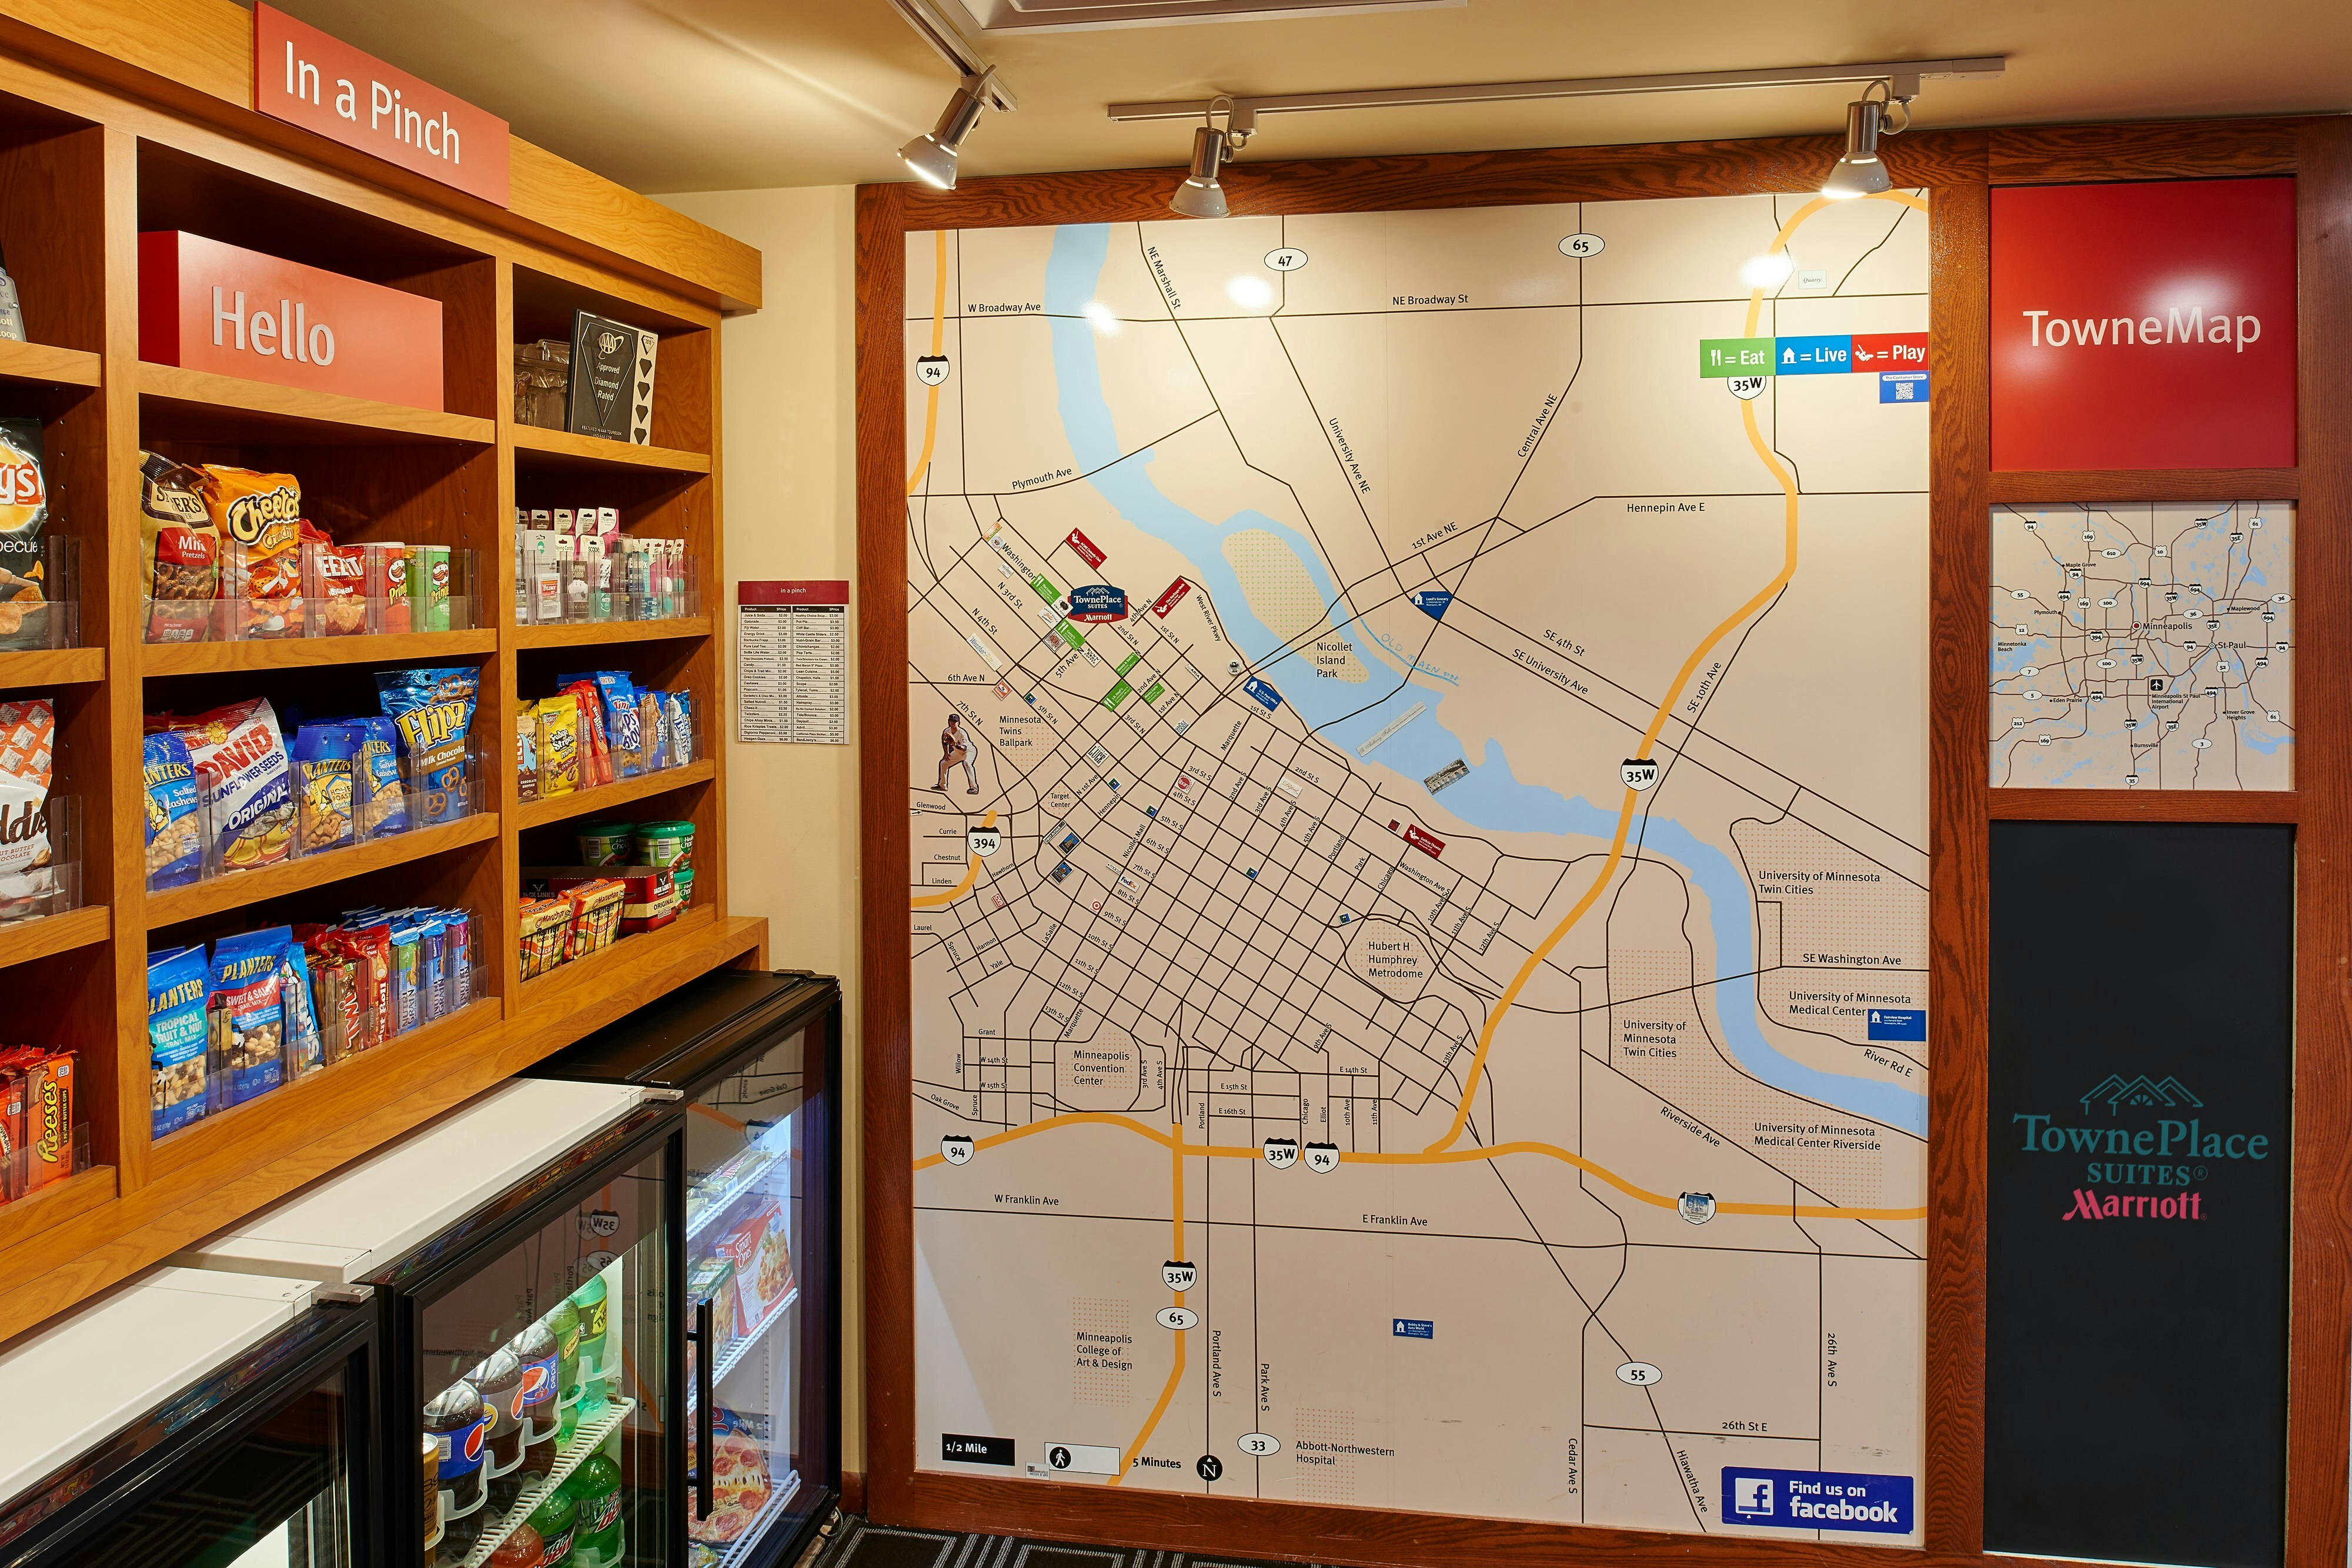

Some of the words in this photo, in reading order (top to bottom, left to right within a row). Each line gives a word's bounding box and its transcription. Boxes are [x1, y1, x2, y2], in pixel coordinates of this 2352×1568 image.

[286, 40, 320, 105] In
[335, 79, 356, 121] a
[372, 80, 460, 164] Pinch
[1573, 240, 1589, 253] 65
[1392, 296, 1405, 305] NE
[1408, 295, 1456, 306] Broadway
[1458, 294, 1468, 303] St
[968, 304, 977, 312] W
[978, 303, 1023, 313] Broadway
[1024, 302, 1041, 312] Ave
[212, 285, 335, 366] Hello
[2023, 306, 2261, 353] TowneMap
[1740, 350, 1765, 365] Eat
[1815, 348, 1847, 363] Live
[1893, 346, 1925, 362] Play
[597, 362, 620, 374] Approved
[926, 367, 940, 379] 94
[594, 377, 619, 389] Diamond
[1733, 377, 1762, 391] 35W
[597, 390, 614, 401] Rated
[1329, 417, 1354, 463] University
[1350, 463, 1362, 481] Ave
[1360, 480, 1371, 494] NE
[1012, 472, 1054, 490] Plymouth
[1054, 467, 1073, 478] Ave
[1627, 503, 1676, 513] Hennepin
[1678, 503, 1696, 512] Ave
[1699, 502, 1705, 511] E
[230, 489, 300, 544] Cheetos
[263, 527, 294, 549] Crunchy
[2142, 621, 2193, 630] Minneapolis
[1317, 642, 1352, 651] Nicollet
[1381, 633, 1403, 651] OLD
[1544, 630, 1557, 641] SE
[1556, 638, 1572, 650] 4th
[1573, 646, 1585, 656] St
[1317, 656, 1345, 665] Island
[1317, 669, 1338, 678] Park
[397, 700, 468, 748] Flipz
[551, 729, 568, 741] Fudge
[552, 735, 574, 751] Stripes
[1000, 739, 1033, 748] Ballpark
[194, 724, 273, 789] DAVID
[202, 763, 262, 808] SUNFLOWER
[259, 751, 284, 774] SEEDS
[1626, 769, 1654, 782] 35W
[173, 787, 196, 797] Salted
[917, 802, 946, 810] Glenwood
[974, 838, 995, 848] 394
[1759, 871, 1810, 882] University
[1813, 872, 1822, 881] of
[1825, 872, 1880, 882] Minnesota
[1759, 885, 1780, 894] Twin
[1783, 885, 1813, 894] Cities
[654, 898, 674, 910] ORIGINAL
[1368, 941, 1399, 951] Hubert
[1402, 942, 1409, 951] H
[1368, 955, 1418, 967] Humphrey
[1803, 954, 1816, 962] SE
[1818, 954, 1879, 966] Washington
[1882, 956, 1902, 965] Ave
[222, 956, 276, 982] PLANTERS
[1368, 968, 1423, 978] Metrodome
[1789, 991, 1840, 1003] University
[1843, 992, 1854, 1001] of
[1857, 994, 1911, 1004] Minnesota
[1789, 1005, 1829, 1015] Medical
[1832, 1007, 1866, 1016] Center
[156, 1013, 199, 1032] TROPICAL
[1074, 1051, 1130, 1062] Minneapolis
[1074, 1064, 1124, 1073] Convention
[1074, 1076, 1103, 1085] Center
[37, 1081, 58, 1163] Reese's
[1755, 1123, 1805, 1135] University
[1808, 1124, 1818, 1133] of
[1821, 1125, 1875, 1136] Minnesota
[2013, 1113, 2269, 1159] TownePlace
[1755, 1137, 1795, 1146] Medical
[1797, 1138, 1831, 1148] Center
[1833, 1139, 1880, 1150] Riverside
[2087, 1163, 2190, 1186] SUITES
[2062, 1188, 2201, 1221] Marriott
[1363, 1215, 1368, 1223] E
[1370, 1215, 1408, 1225] Franklin
[1411, 1217, 1428, 1226] Ave
[736, 1233, 751, 1258] Smart
[739, 1246, 751, 1268] Ones
[1077, 1332, 1132, 1344] Minneapolis
[1077, 1345, 1110, 1357] College
[1112, 1347, 1121, 1356] of
[1077, 1358, 1090, 1366] Art
[1093, 1359, 1099, 1368] &
[1101, 1360, 1132, 1371] Design
[1631, 1370, 1645, 1380] 55
[946, 1443, 963, 1452] 1/2
[965, 1443, 987, 1454] Mile
[1296, 1441, 1395, 1456] Abbott-Northwestern
[1133, 1459, 1138, 1467] 5
[1141, 1457, 1181, 1469] Minutes
[1297, 1455, 1335, 1466] Hospital
[1790, 1482, 1821, 1494] Find
[1825, 1485, 1842, 1496] us
[1847, 1486, 1866, 1497] on
[1790, 1496, 1897, 1523] facebook
